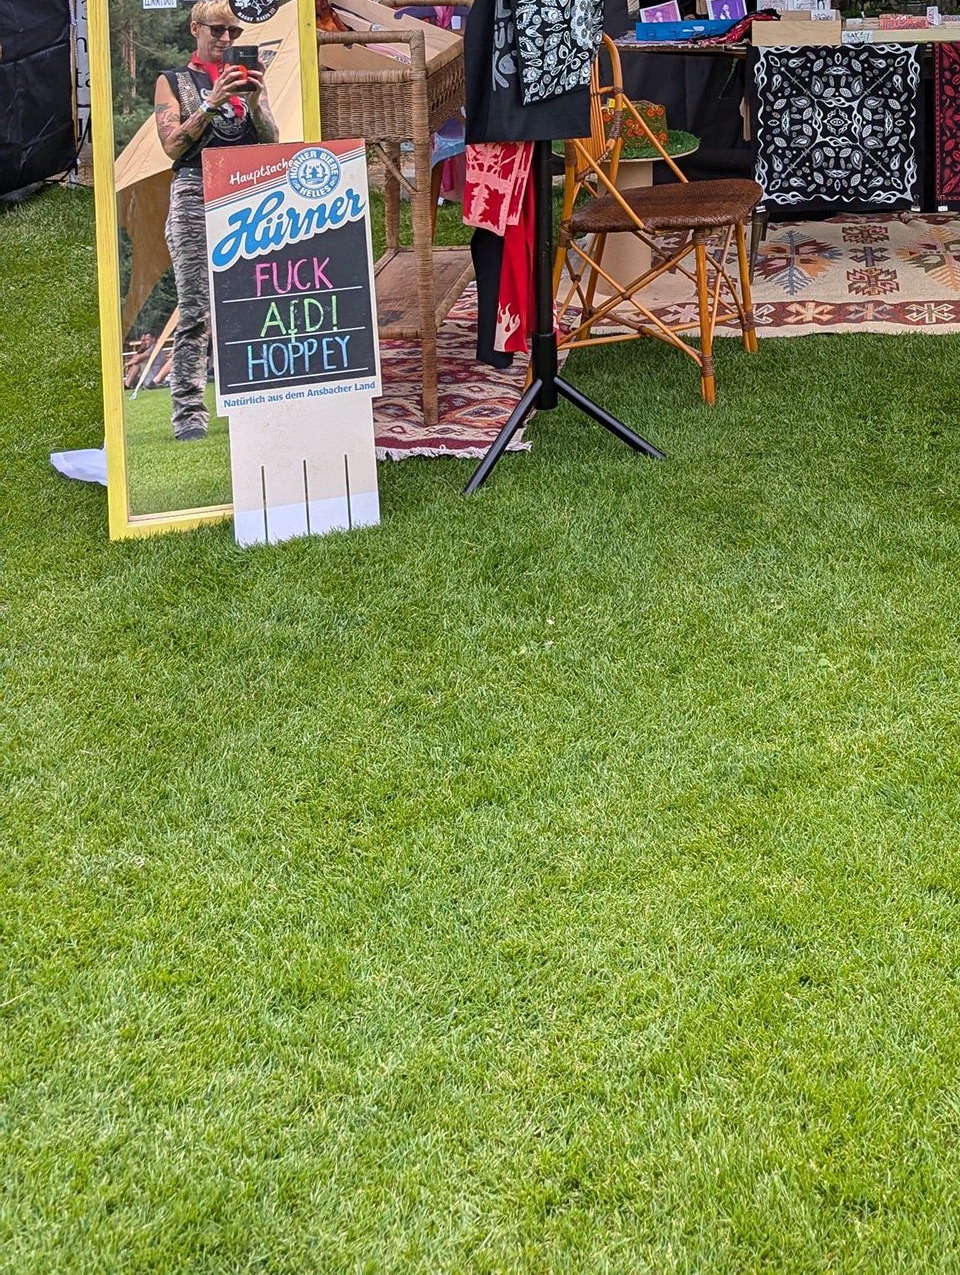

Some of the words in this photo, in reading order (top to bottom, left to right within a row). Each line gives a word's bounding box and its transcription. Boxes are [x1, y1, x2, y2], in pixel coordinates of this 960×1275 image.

[229, 157, 294, 186] Hauptsache
[319, 152, 339, 176] BIERE
[299, 186, 332, 198] HELLES
[211, 188, 367, 268] Hürner
[254, 256, 334, 297] FUCK
[246, 335, 350, 381] HOPPEY
[223, 395, 266, 408] Natürlich
[267, 394, 284, 402] aus
[285, 389, 305, 400] dem
[306, 386, 352, 398] Ansbacher
[354, 381, 376, 391] Land
